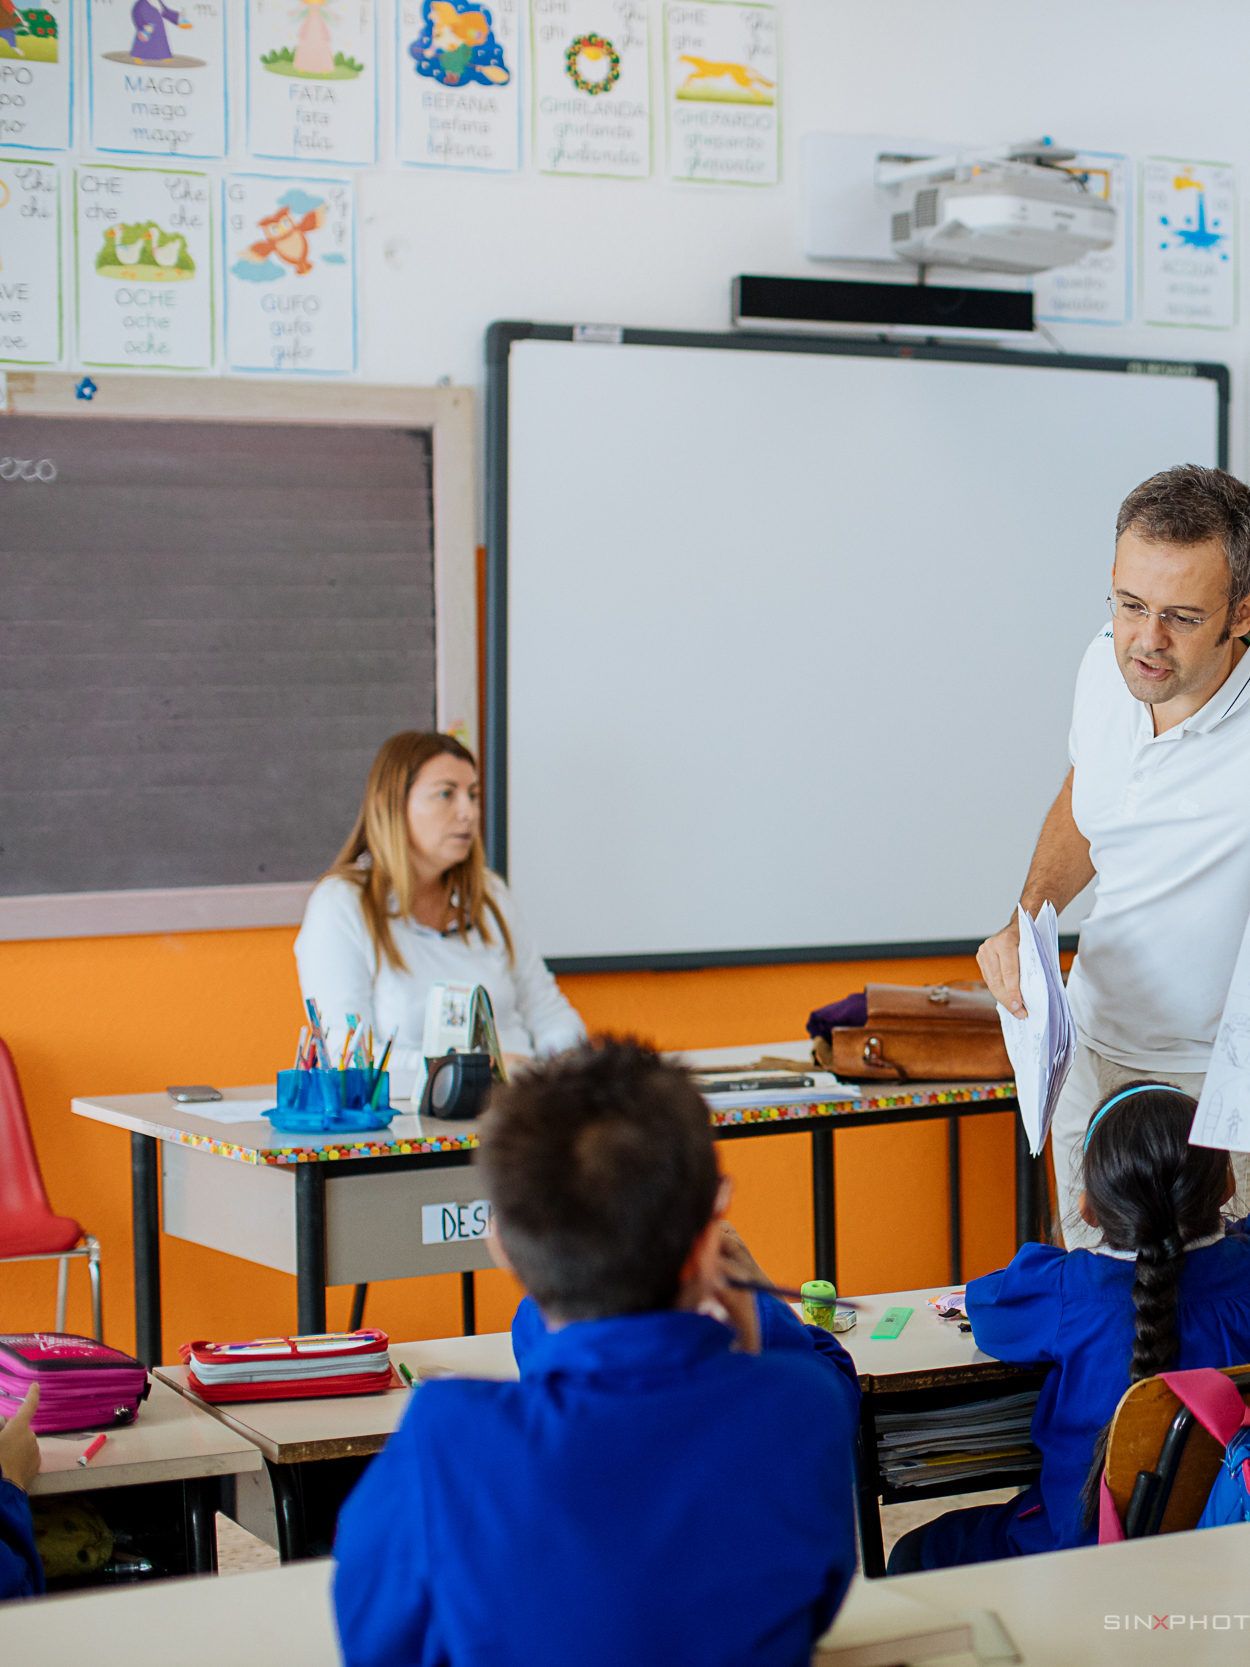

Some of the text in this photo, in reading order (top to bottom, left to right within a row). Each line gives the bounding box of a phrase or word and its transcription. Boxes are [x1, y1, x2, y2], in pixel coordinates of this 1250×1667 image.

[0, 66, 33, 84] PO
[124, 75, 194, 96] MAGO
[290, 84, 337, 104] FATA
[131, 102, 187, 121] mago
[422, 91, 498, 114] BEFANA
[540, 95, 646, 118] GHIRLANDA
[296, 106, 331, 125] fata
[673, 107, 774, 131] GHEPARDO
[132, 126, 194, 152] mago
[79, 175, 124, 194] CHE
[85, 203, 119, 220] che
[0, 282, 30, 300] VE
[114, 287, 178, 307] OCHE
[260, 293, 321, 315] GUFO
[122, 311, 171, 330] oche
[269, 316, 313, 338] gufo
[123, 332, 172, 356] oche
